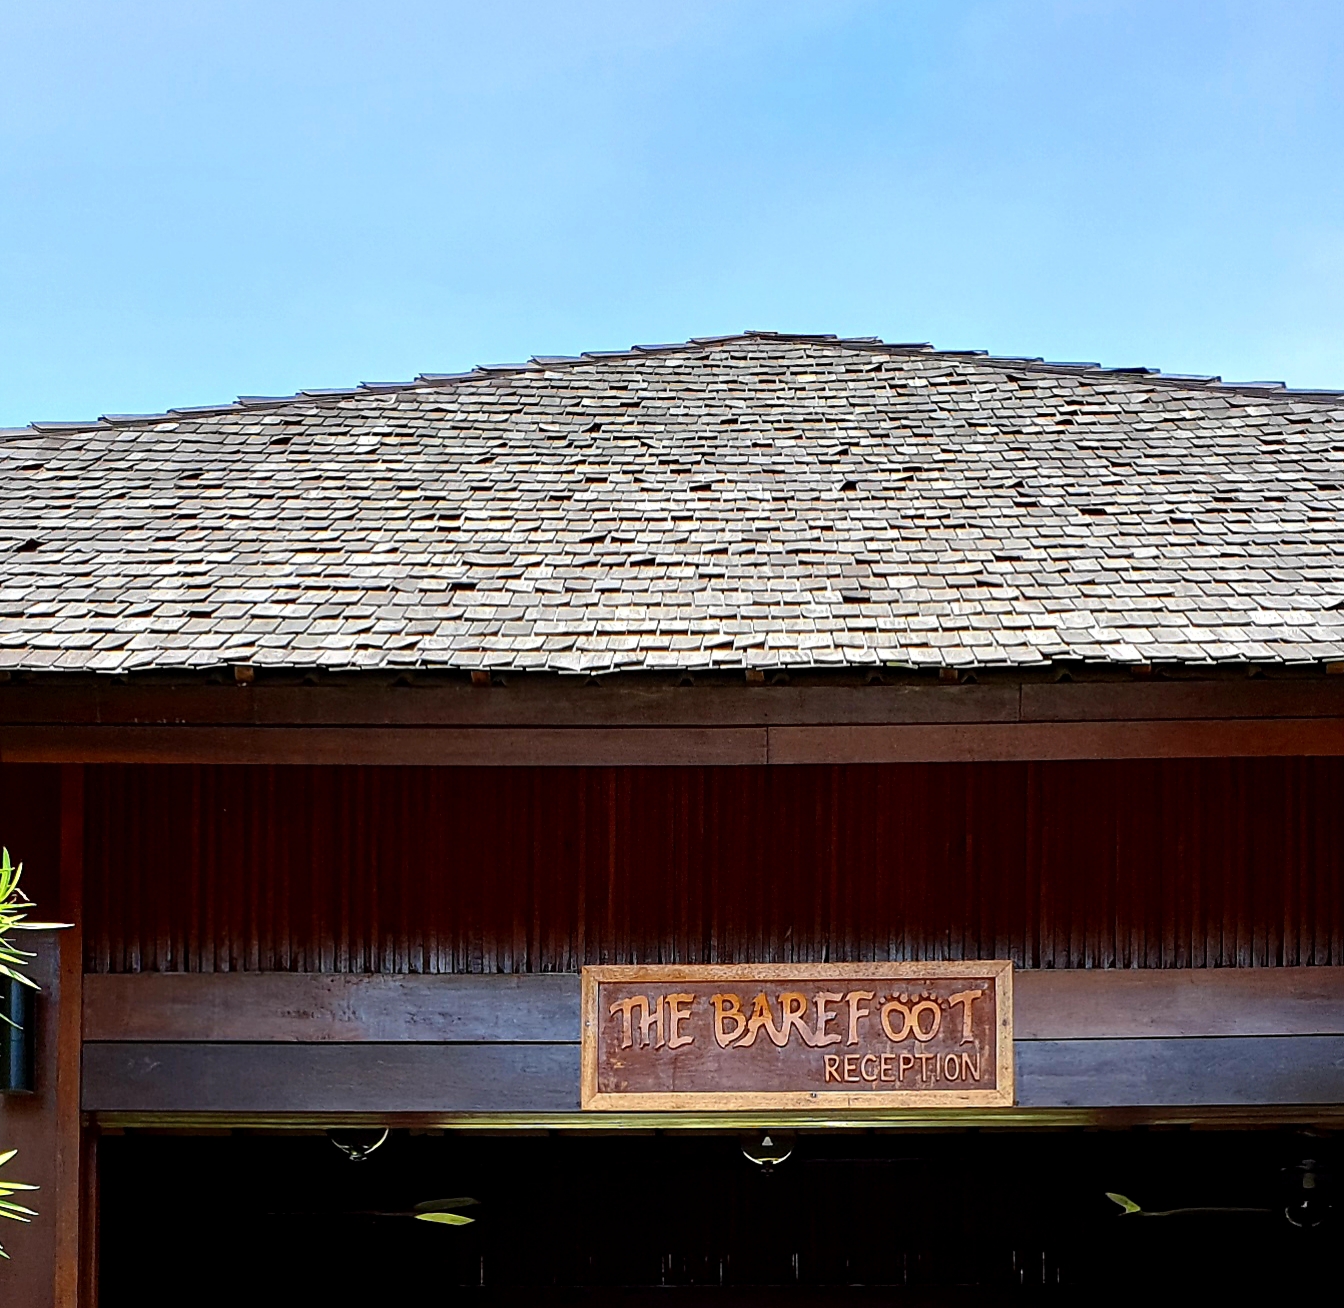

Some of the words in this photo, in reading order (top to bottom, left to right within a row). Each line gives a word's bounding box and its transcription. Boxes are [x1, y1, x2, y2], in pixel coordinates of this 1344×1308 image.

[609, 993, 696, 1049] THE
[710, 989, 983, 1048] BAREFOOT
[824, 1054, 981, 1082] RECEPTION
